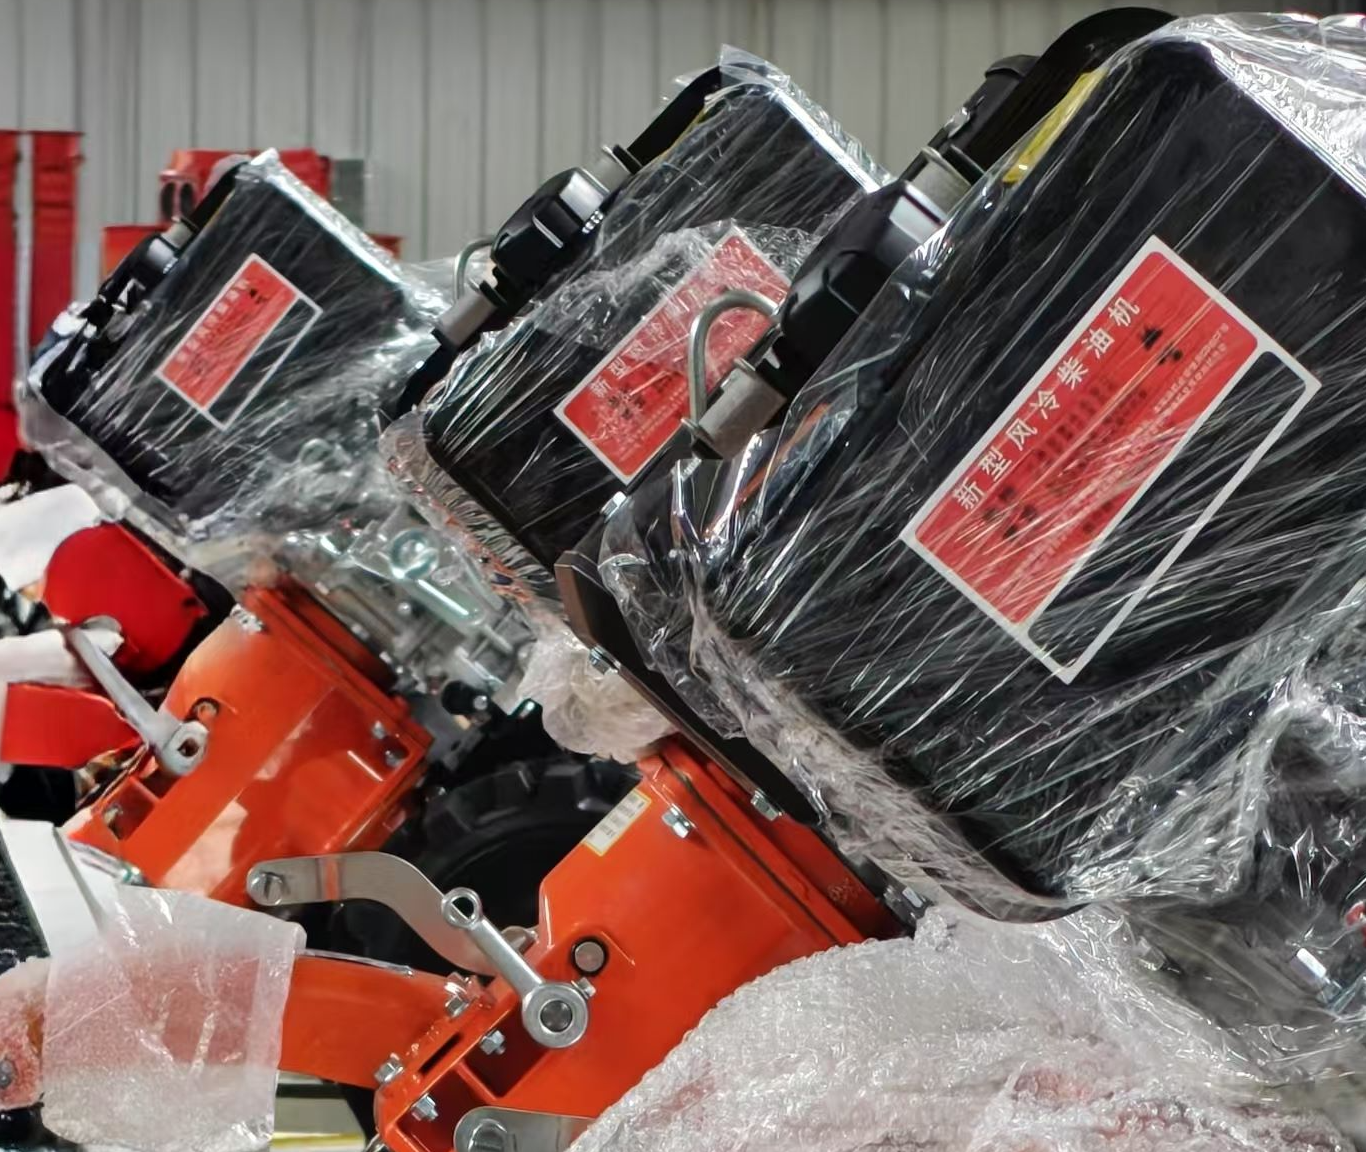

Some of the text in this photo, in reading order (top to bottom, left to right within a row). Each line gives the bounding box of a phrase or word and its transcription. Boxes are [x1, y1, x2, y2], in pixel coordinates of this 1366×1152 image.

[952, 297, 1141, 511] 新型风冷柴油机
